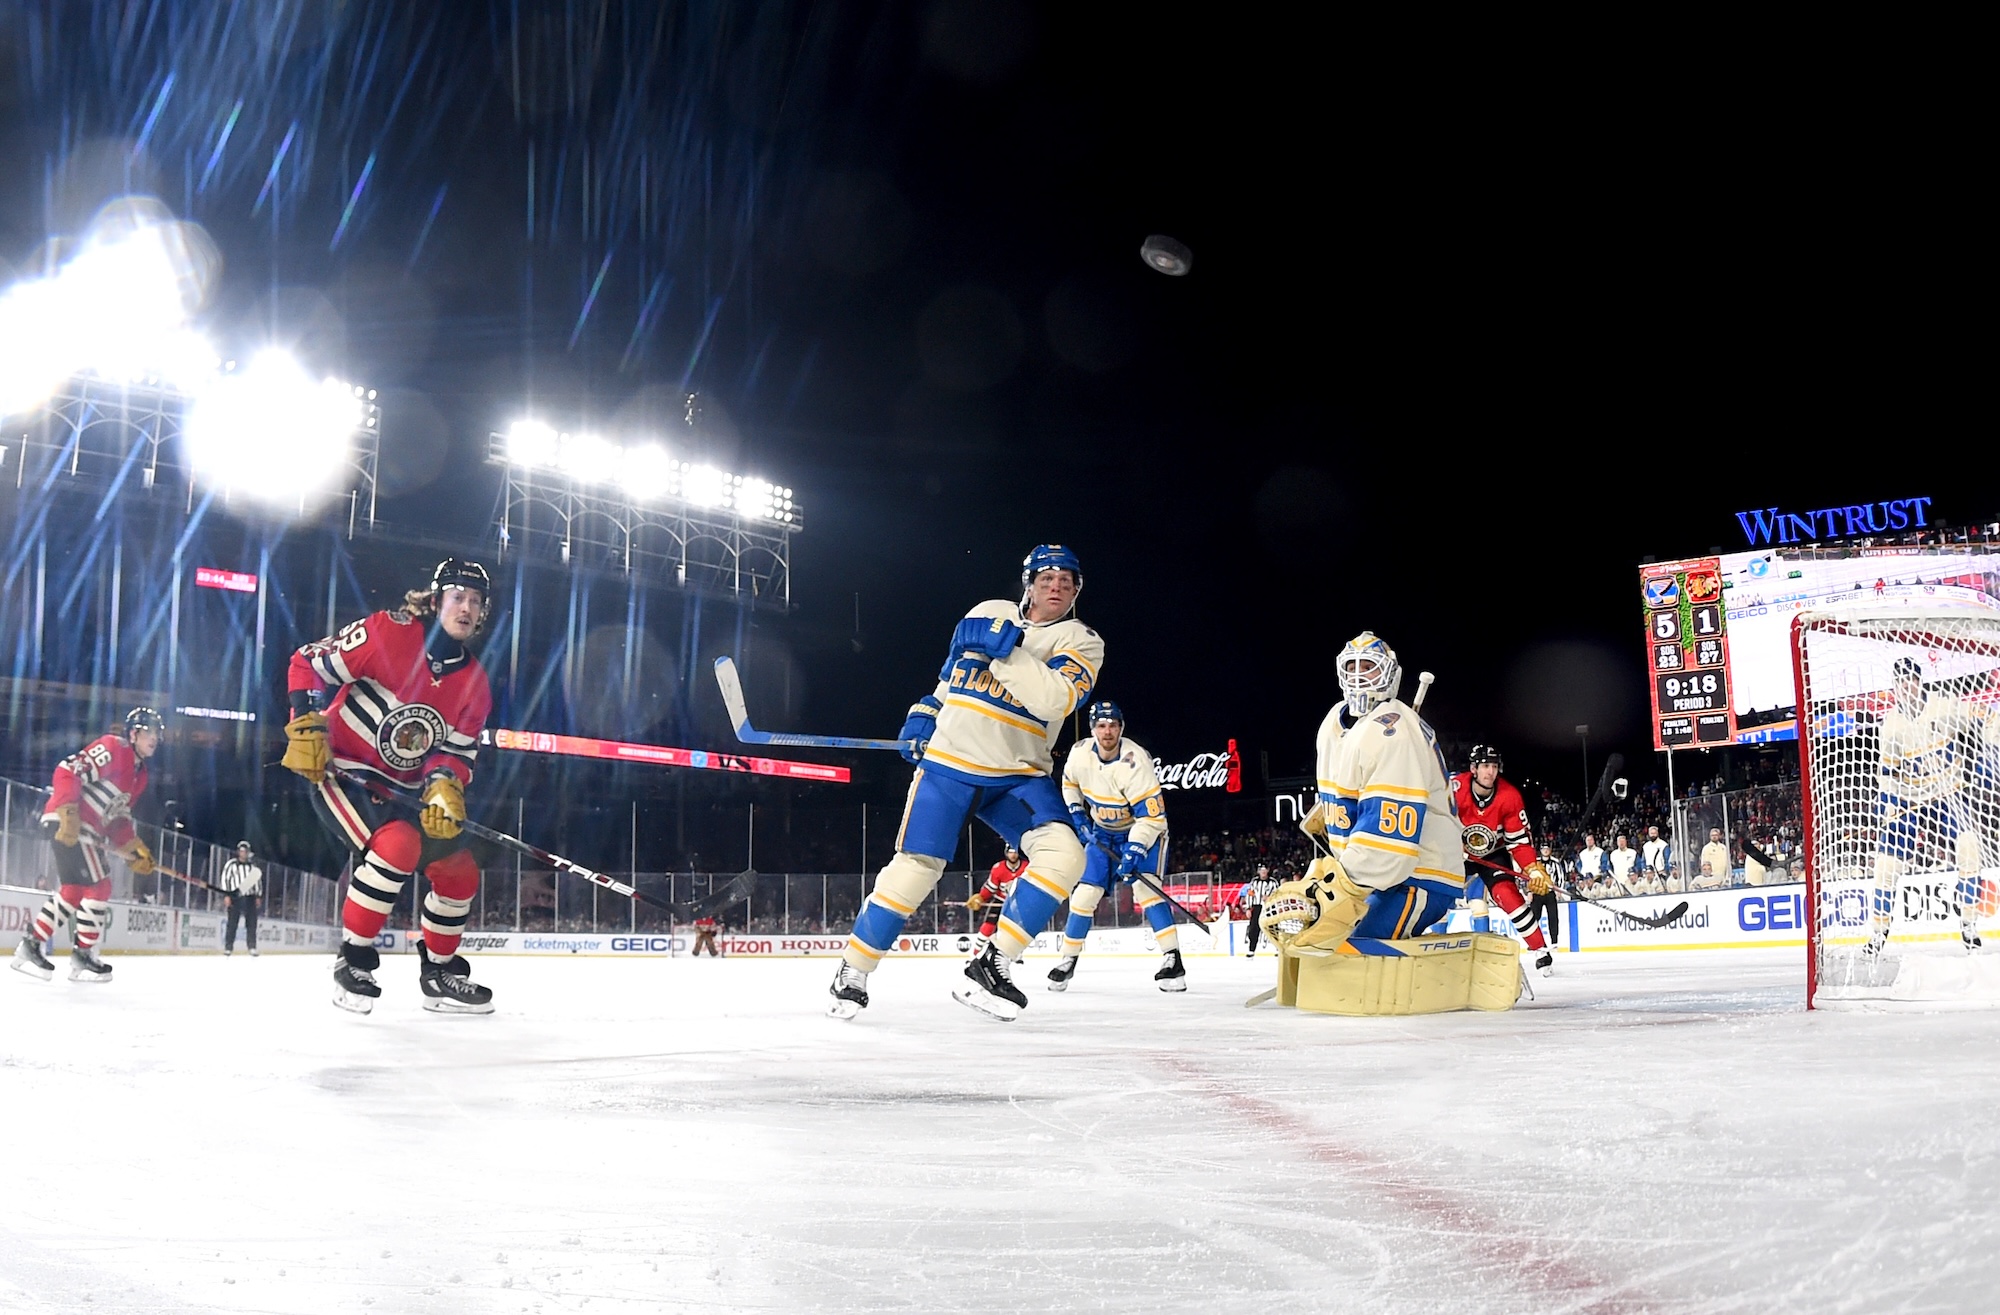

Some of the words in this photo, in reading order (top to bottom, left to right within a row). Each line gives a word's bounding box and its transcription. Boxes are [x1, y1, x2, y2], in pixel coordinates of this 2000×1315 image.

[1735, 497, 1931, 546] WINTRUST
[1698, 609, 1715, 633] 1
[1727, 607, 1768, 620] GEICO
[1656, 613, 1676, 638] 5
[1659, 655, 1679, 668] 22
[1700, 651, 1719, 664] 27
[1665, 674, 1718, 697] 9:18
[1673, 697, 1705, 711] PERIOD
[1705, 696, 1712, 708] 3
[88, 743, 112, 768] 86
[1379, 800, 1418, 838] 50
[548, 853, 636, 897] TRUE
[1738, 888, 1869, 932] GEICO
[523, 937, 602, 951] ticketmaster
[611, 937, 687, 952] GEICO
[1418, 939, 1472, 952] TRUE
